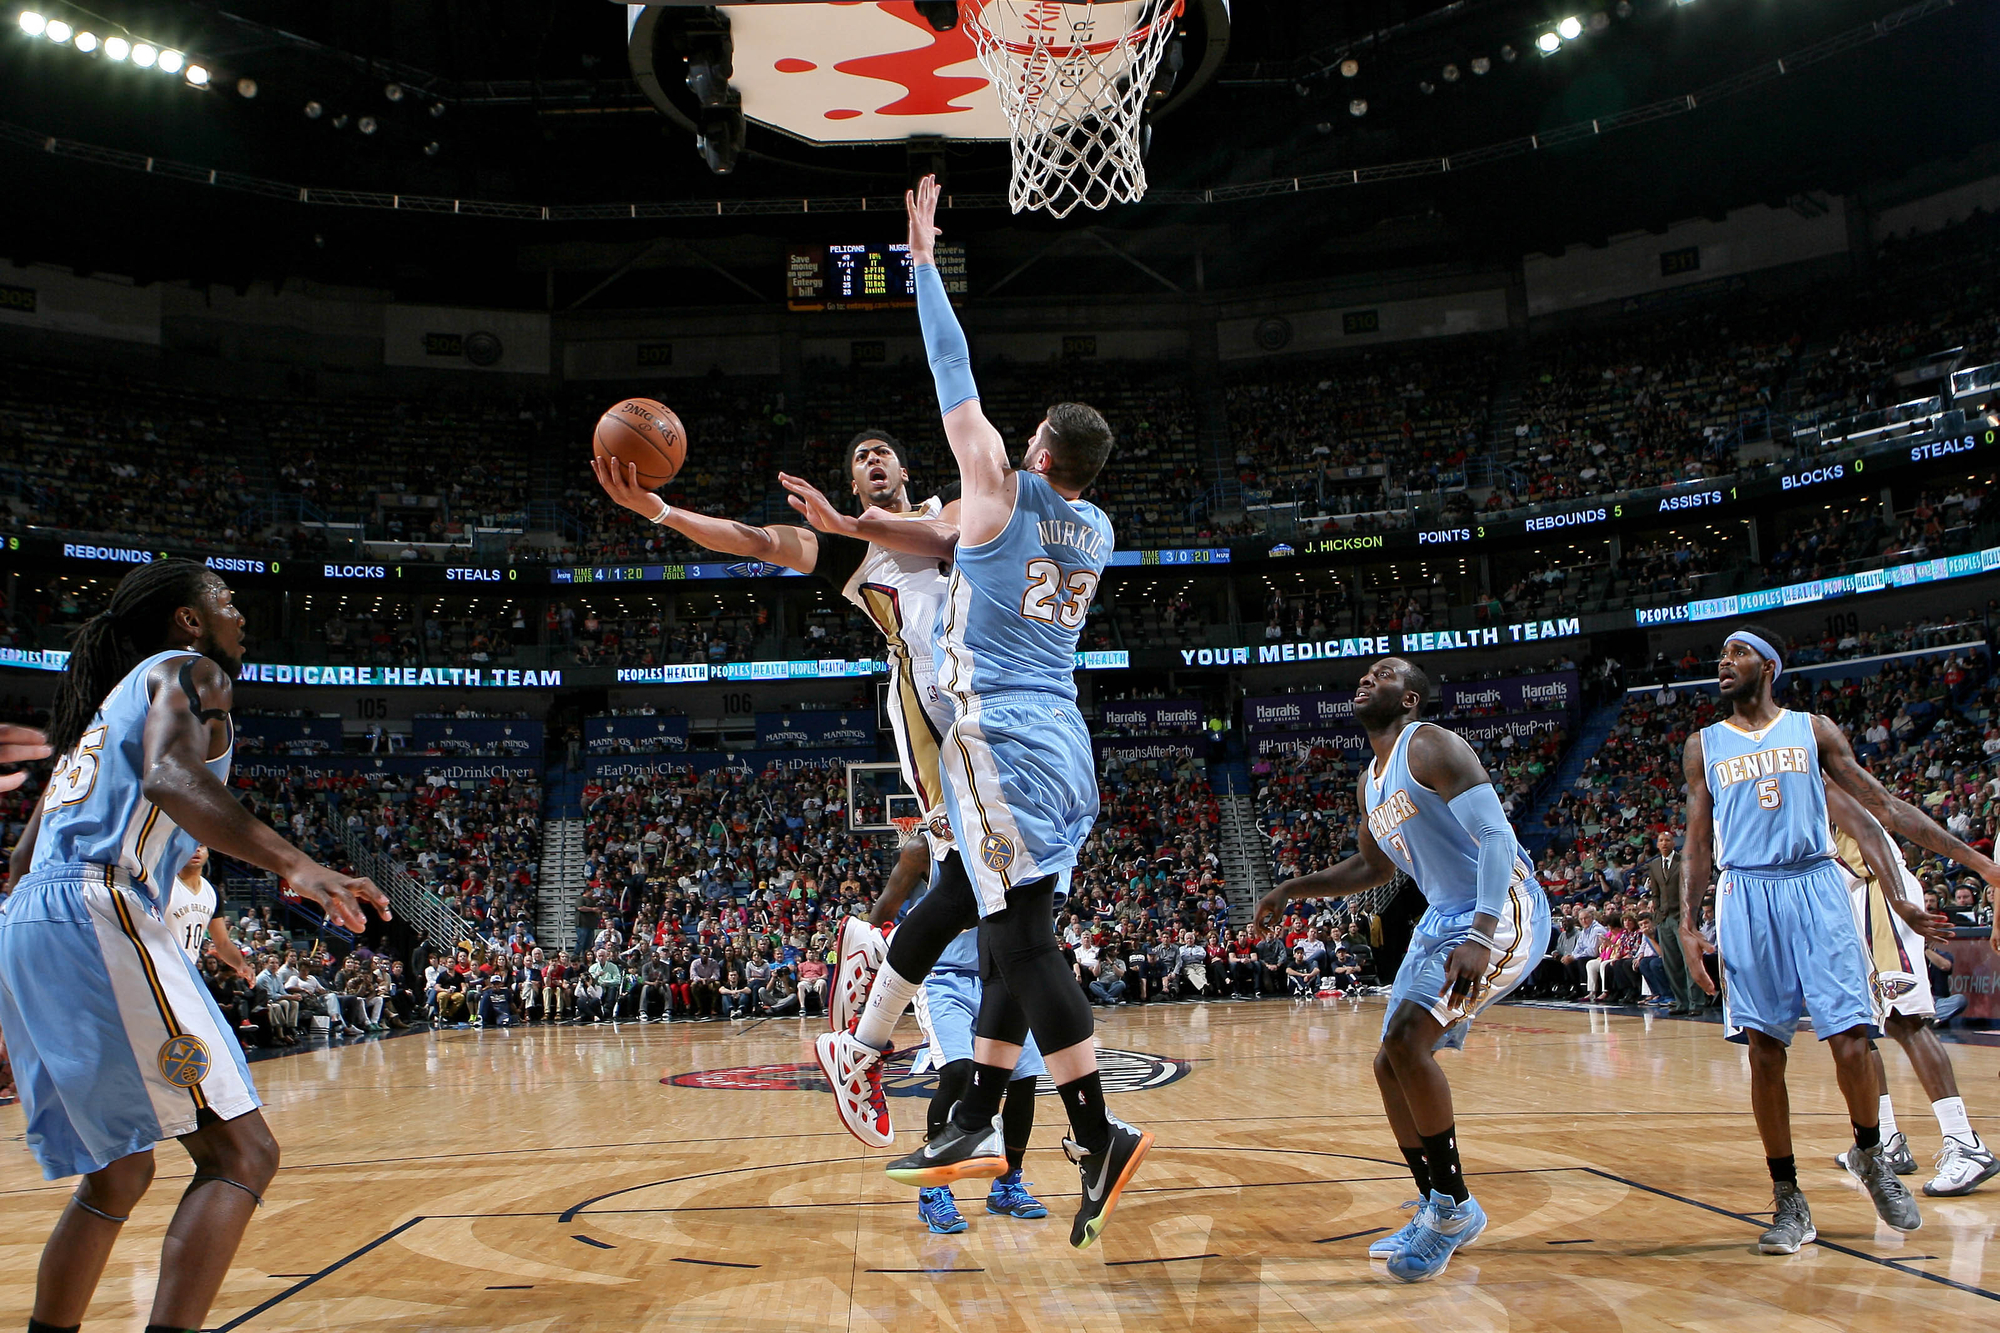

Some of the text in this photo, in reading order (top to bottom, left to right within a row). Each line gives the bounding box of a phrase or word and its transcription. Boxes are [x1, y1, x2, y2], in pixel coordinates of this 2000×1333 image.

[829, 245, 865, 253] PELICANS
[790, 255, 810, 263] Save
[791, 263, 818, 272] money
[793, 278, 823, 287] Entergy
[799, 287, 816, 296] bill.
[1911, 431, 1994, 461] STEALS 0
[1782, 460, 1863, 490] BLOCKS 0
[1659, 487, 1737, 511] ASSISTS 1
[1525, 506, 1622, 531] REBOUNDS 5
[9, 537, 19, 550] 9
[1418, 526, 1485, 544] POINTS 3
[63, 543, 152, 563] REBOUNDS
[1305, 541, 1316, 553] J.
[1320, 536, 1383, 551] HICKSON
[1141, 550, 1159, 558] TIME
[1141, 557, 1160, 565] OUTS
[204, 556, 279, 573] ASSISTS 0
[324, 565, 402, 578] BLOCKS 1
[574, 568, 593, 576] TIME
[664, 565, 684, 573] TEAM
[693, 566, 700, 577] 3
[1949, 555, 1981, 574] PEOPLES
[446, 568, 517, 581] STEALS 0
[574, 575, 593, 583] OUTS
[1020, 558, 1099, 629] 23
[1639, 605, 1688, 623] PEOPLES
[1694, 598, 1735, 616] HEALTH
[1741, 591, 1781, 609] PEOPLES
[1784, 583, 1821, 601] HEALTH
[1824, 575, 1855, 594] PEOPLES
[1857, 571, 1884, 589] HEALTH
[1825, 612, 1858, 637] 109
[1181, 617, 1580, 666] YOUR MEDICARE HEALTH TEAM
[1086, 653, 1127, 666] HEALTH
[237, 663, 561, 686] MEDICARE HEALTH TEAM
[617, 667, 662, 682] PEOPLES
[666, 666, 705, 680] HEALTH
[711, 664, 749, 678] PEOPLES
[752, 662, 787, 676] HEALTH
[790, 662, 818, 675] PEOPLES
[820, 661, 844, 674] HEALTH
[1456, 689, 1501, 705] Harrah's
[1522, 681, 1567, 699] Harrah's
[356, 698, 388, 719] 105
[722, 693, 752, 714] 106
[1256, 704, 1300, 718] Harrah's
[1106, 711, 1147, 723] Harrah's
[1157, 709, 1198, 722] Harrah's
[1714, 746, 1810, 791] DENVER
[1755, 777, 1782, 811] 5
[1368, 788, 1420, 840] ENVER
[1388, 832, 1413, 863] 7
[173, 904, 190, 919] NEW
[185, 923, 203, 950] 10
